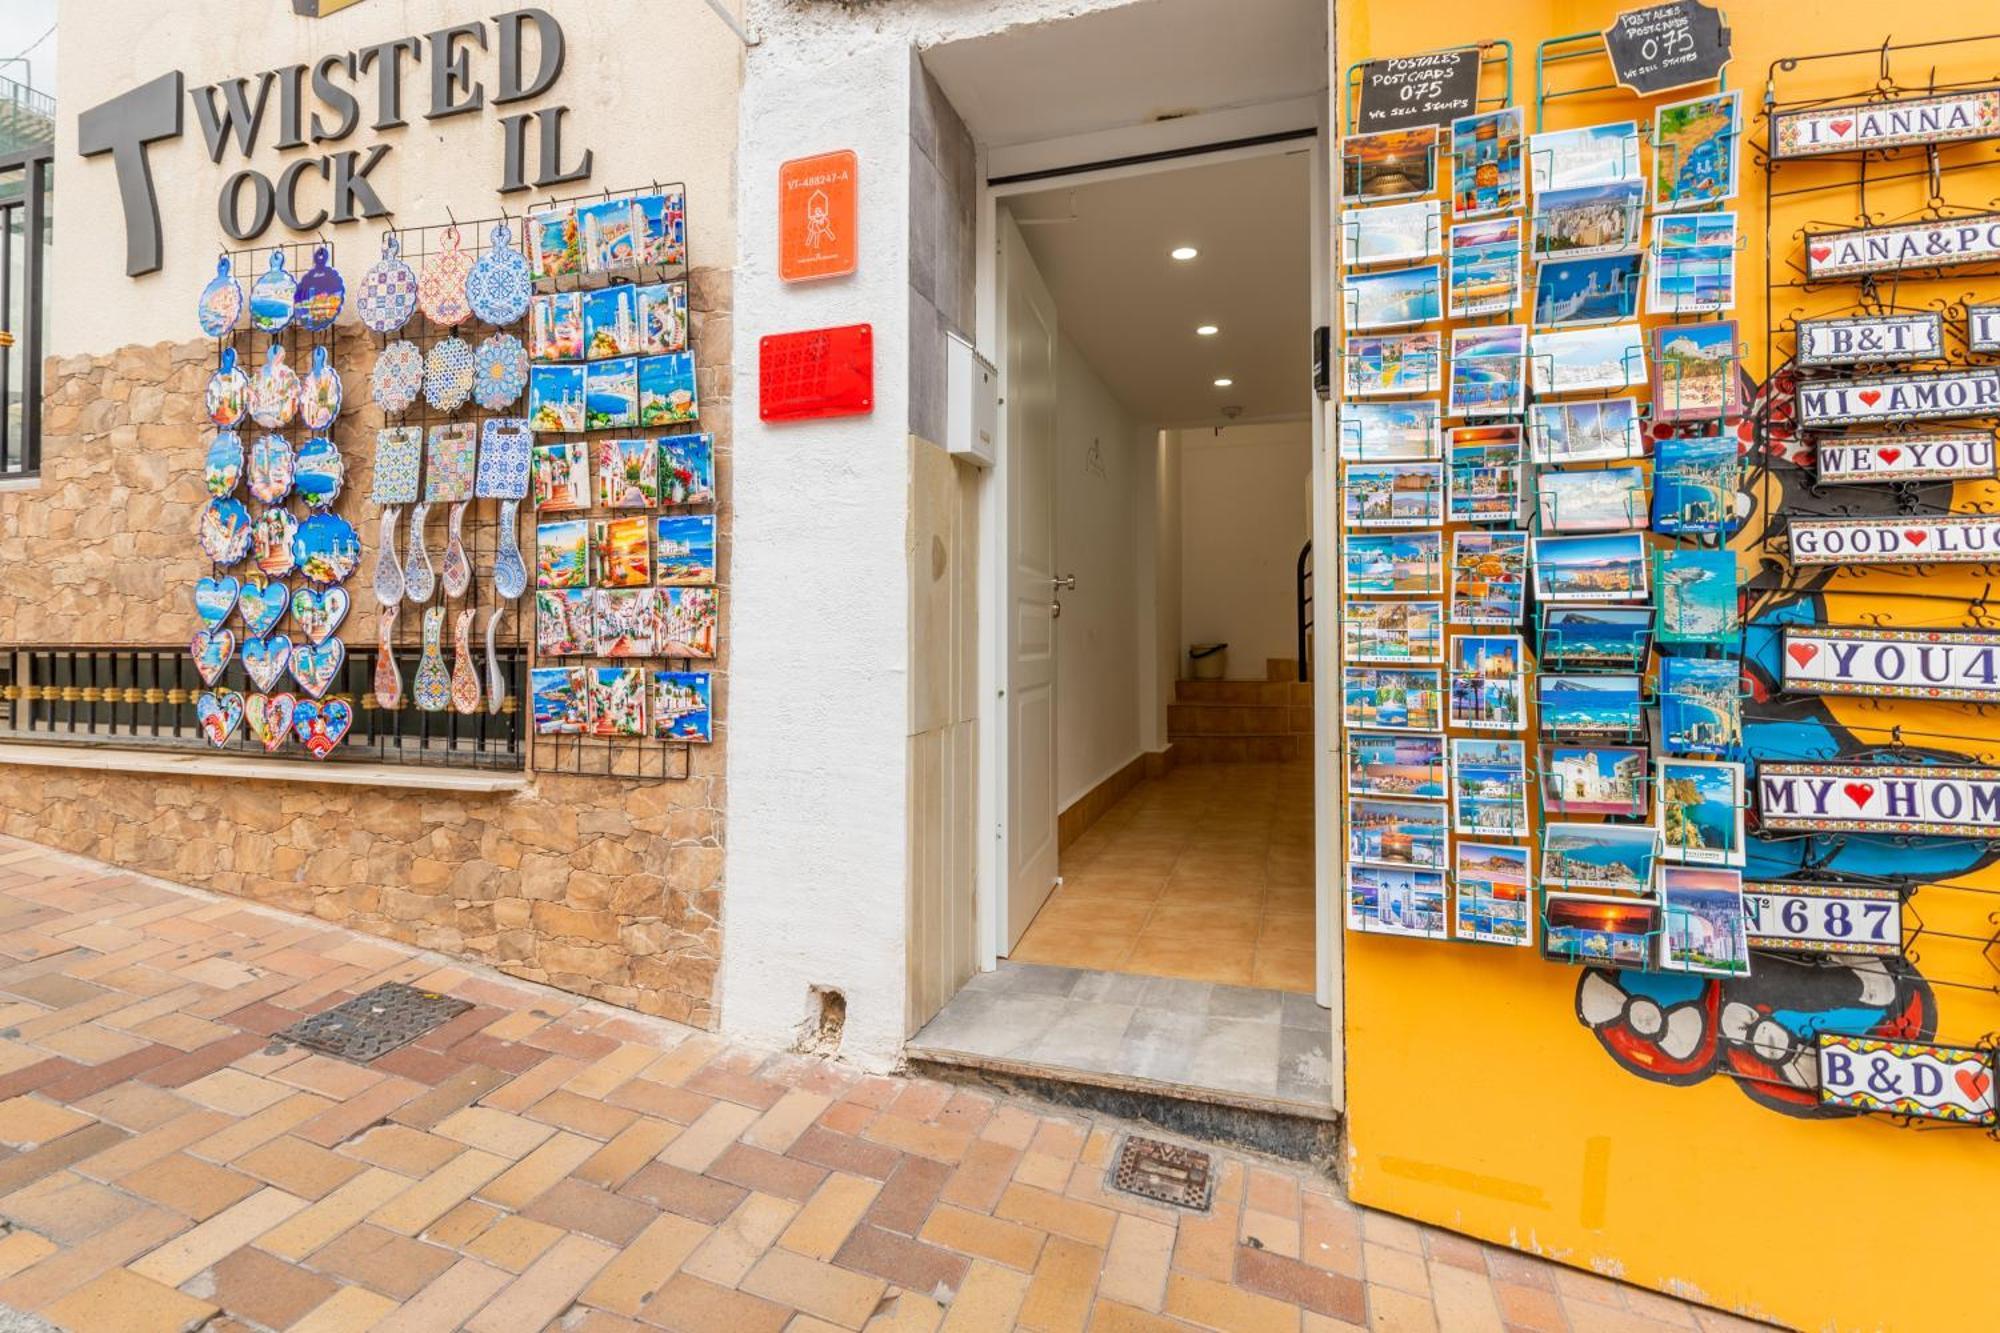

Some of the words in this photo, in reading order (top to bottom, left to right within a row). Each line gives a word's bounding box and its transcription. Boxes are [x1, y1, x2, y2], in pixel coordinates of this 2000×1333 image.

[1387, 52, 1461, 72] POSTALES
[1809, 120, 1822, 143] I
[1860, 104, 1972, 139] ANNA
[1831, 325, 1911, 354] B&T
[1803, 389, 1850, 418] MI
[1887, 379, 2000, 417] AMOR
[1821, 447, 1872, 472] WE
[1905, 442, 1991, 468] YOU
[1795, 528, 1900, 553] GOOD
[1762, 778, 1837, 815] MY
[1825, 1051, 1943, 1098] B&D
